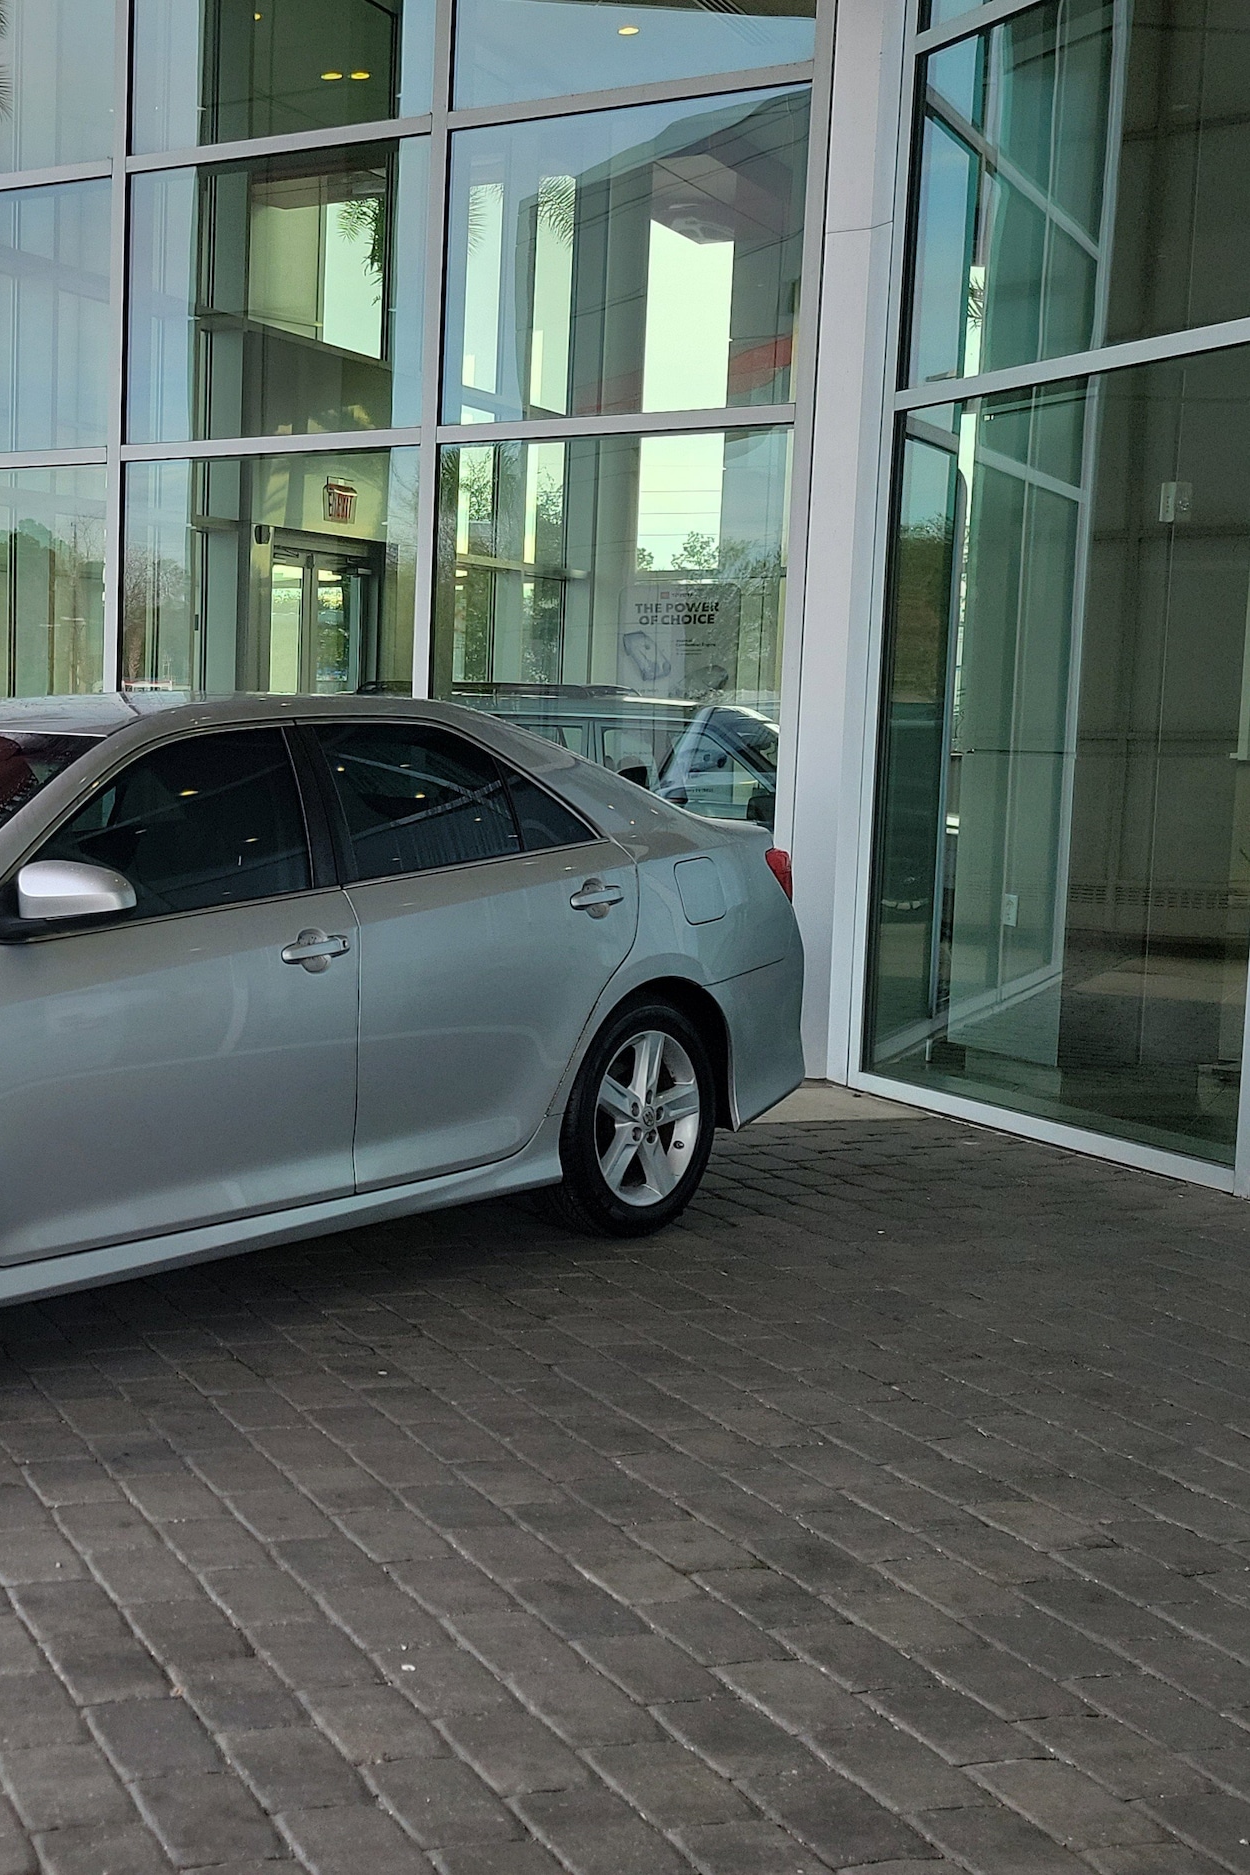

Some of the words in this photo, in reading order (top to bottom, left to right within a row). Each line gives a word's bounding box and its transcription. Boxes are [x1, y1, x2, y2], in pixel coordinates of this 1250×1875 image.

[634, 603, 662, 614] THE
[665, 602, 720, 613] POWER
[638, 615, 659, 626] OF
[660, 613, 716, 625] CHOICE
